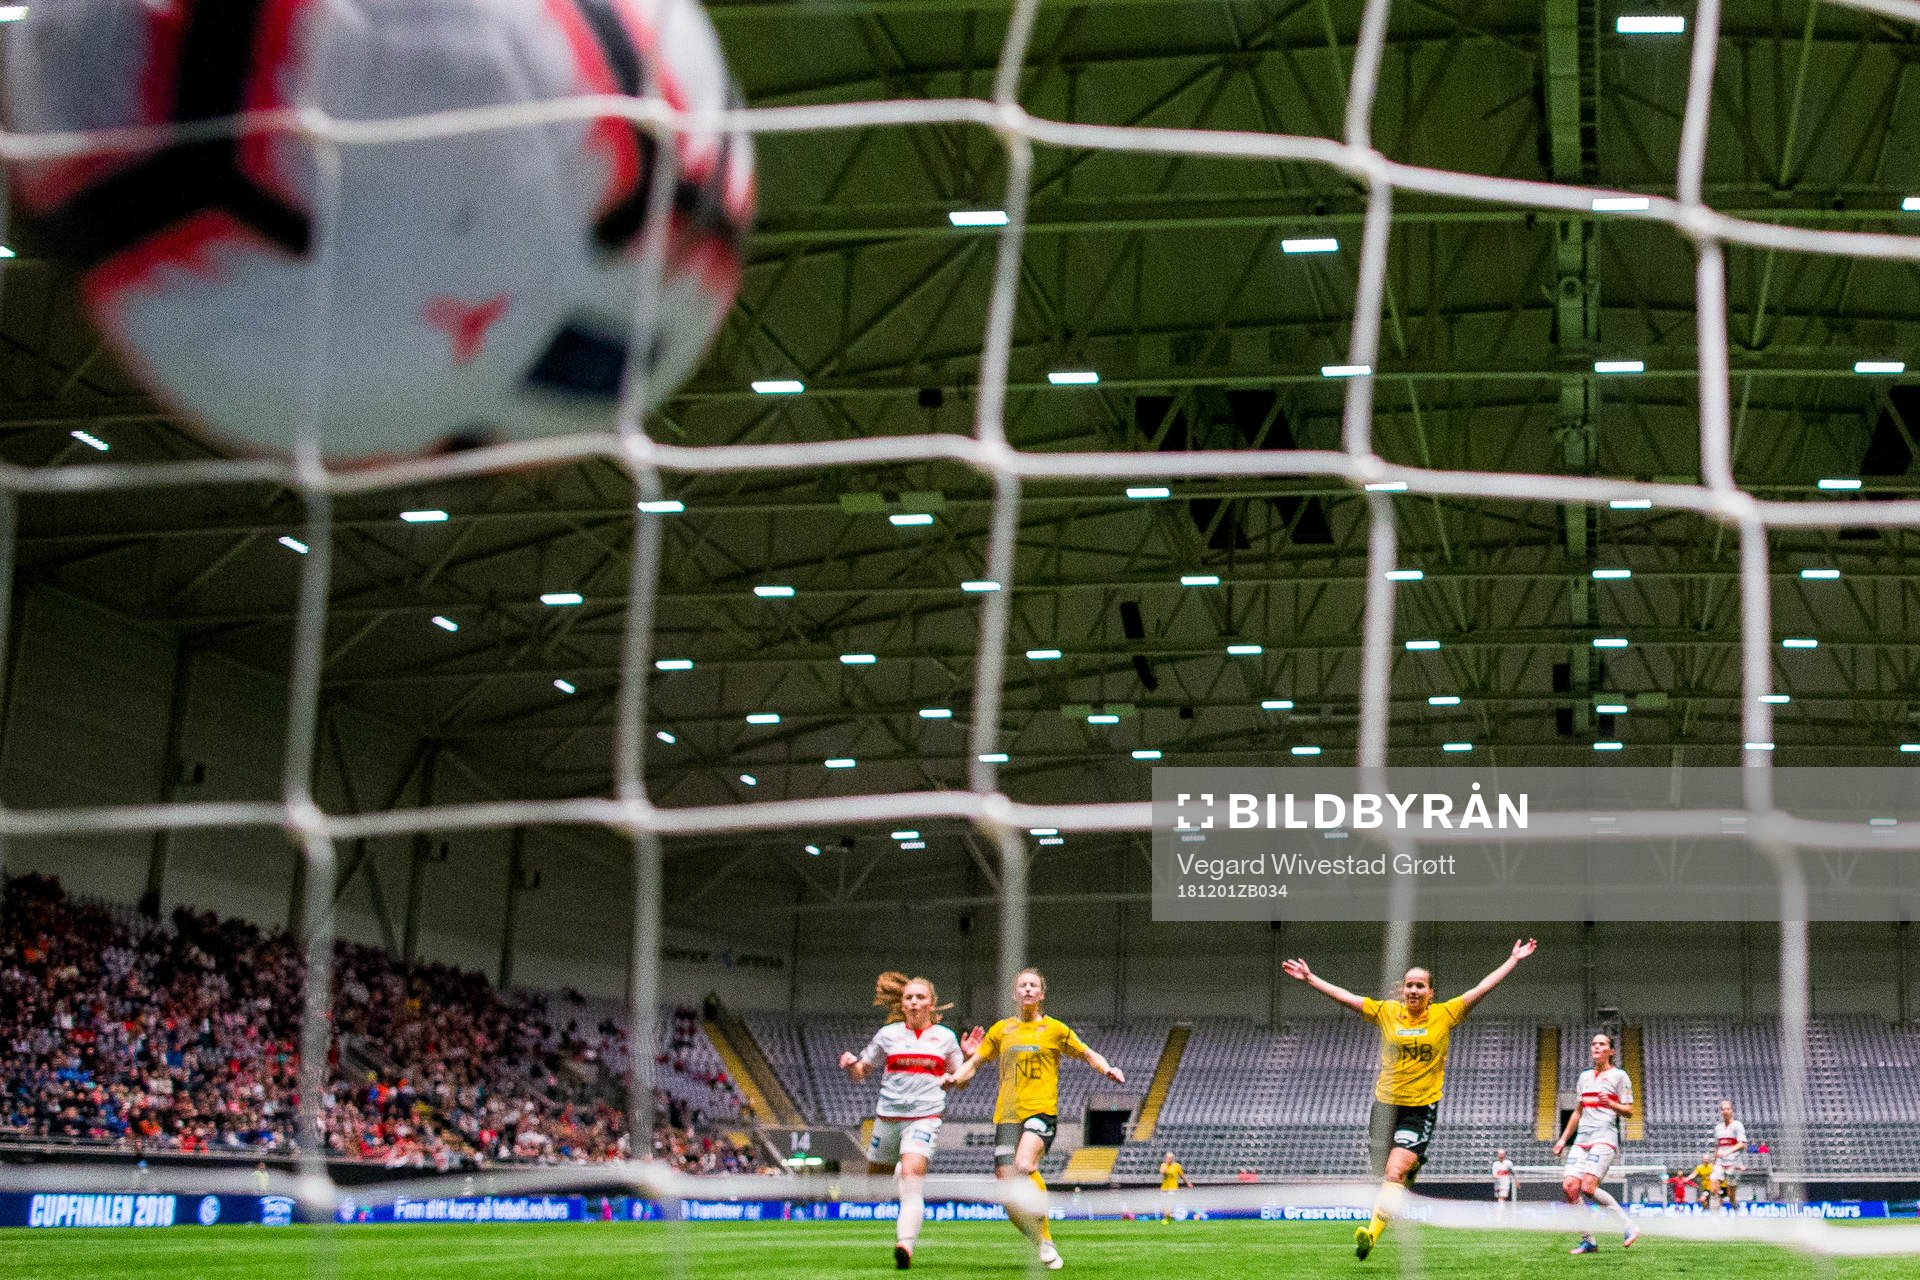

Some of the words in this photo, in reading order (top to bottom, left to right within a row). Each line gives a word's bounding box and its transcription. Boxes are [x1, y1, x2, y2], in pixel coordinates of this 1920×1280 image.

[790, 1131, 811, 1152] 14
[29, 1194, 133, 1227] CUPFINALEN
[134, 1194, 177, 1227] 2018
[839, 1202, 872, 1218] Finn
